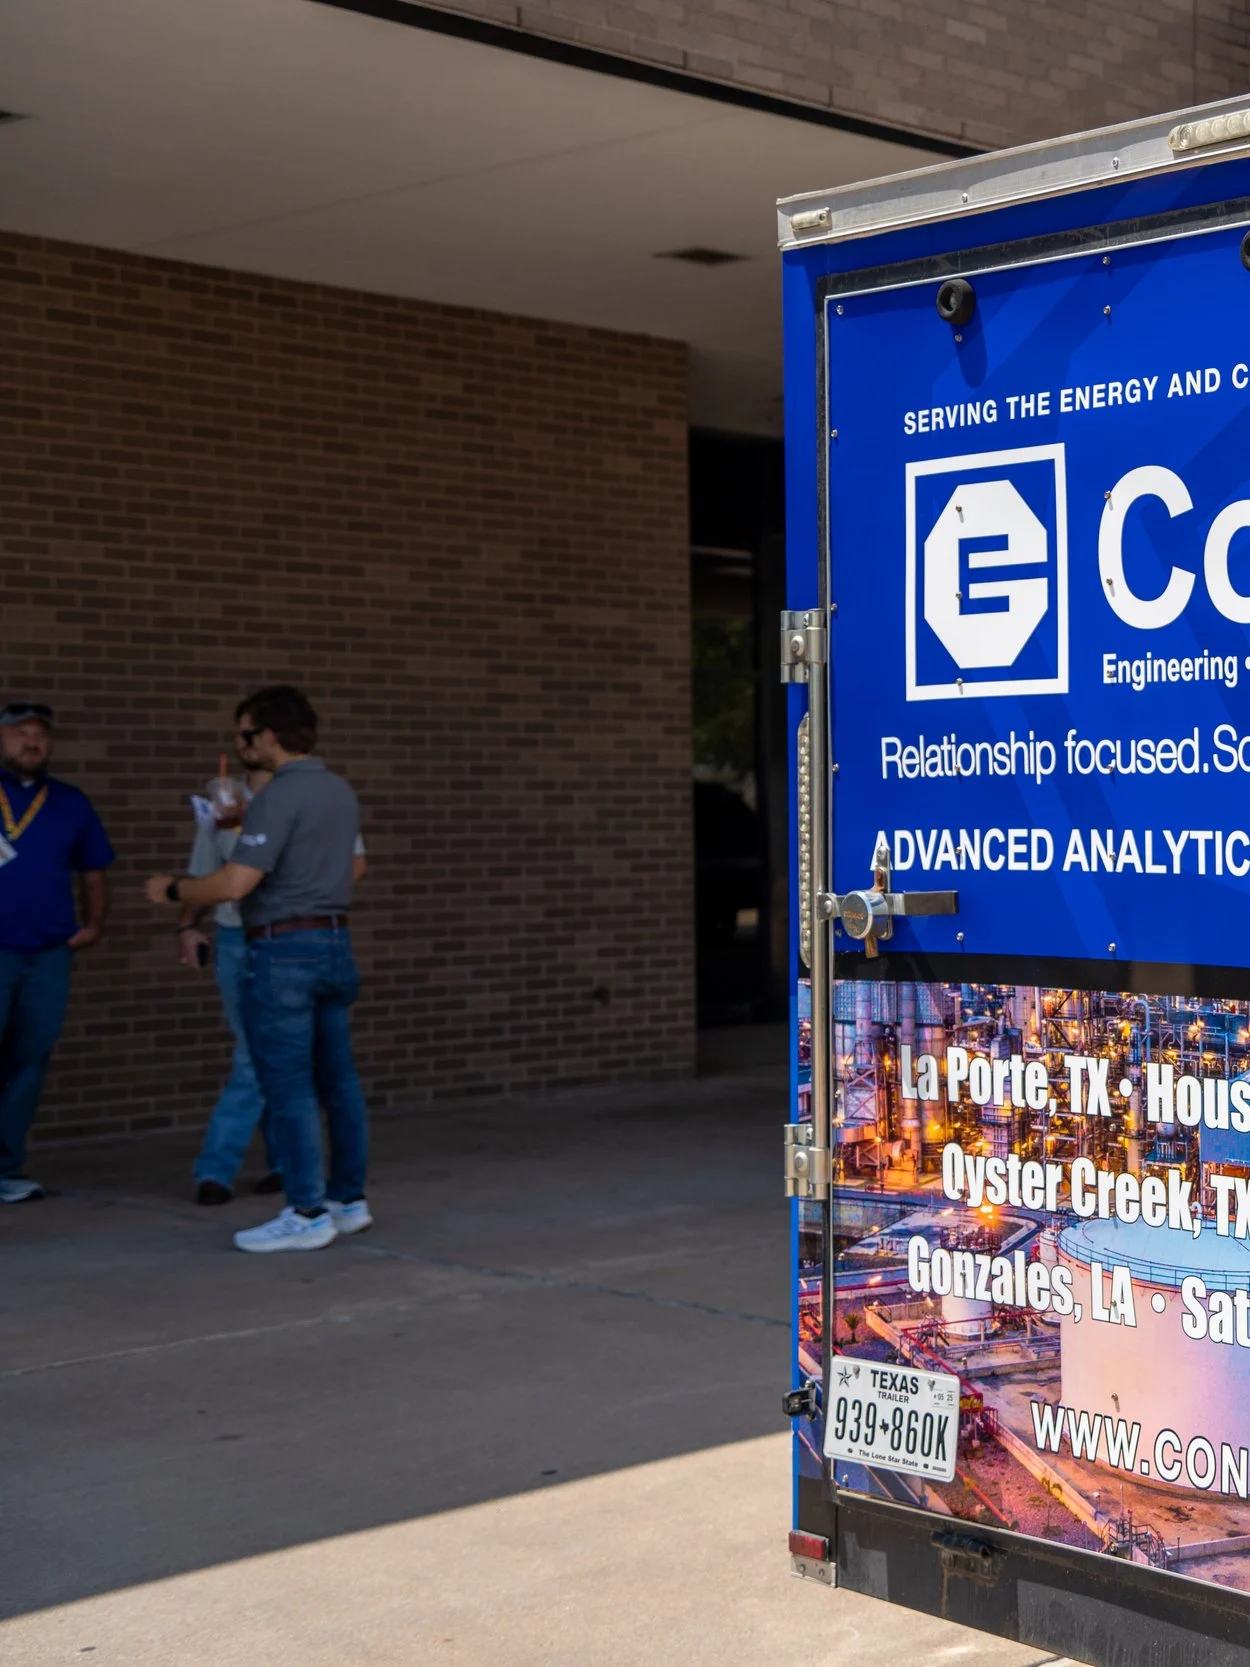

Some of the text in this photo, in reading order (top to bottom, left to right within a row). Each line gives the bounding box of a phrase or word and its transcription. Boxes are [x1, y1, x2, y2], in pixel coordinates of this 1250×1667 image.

[904, 400, 997, 434] SERVING
[1007, 392, 1050, 419] THE
[1060, 376, 1159, 413] ENERGY
[1167, 368, 1220, 398] AND
[1103, 648, 1238, 691] Engineering
[881, 730, 1057, 785] Relationship
[870, 828, 1053, 871] ADVANCED
[900, 1044, 939, 1101] La
[947, 1046, 1057, 1117] Porte,
[1064, 1054, 1112, 1117] TX
[942, 1143, 1063, 1209] Oyster
[1070, 1156, 1202, 1239] Creek,
[908, 1235, 1081, 1323] Gonzales,
[1091, 1262, 1137, 1328] LA
[871, 1369, 919, 1394] TEXAS
[877, 1391, 909, 1404] TRAILER
[858, 1449, 919, 1467] The Lone Star State
